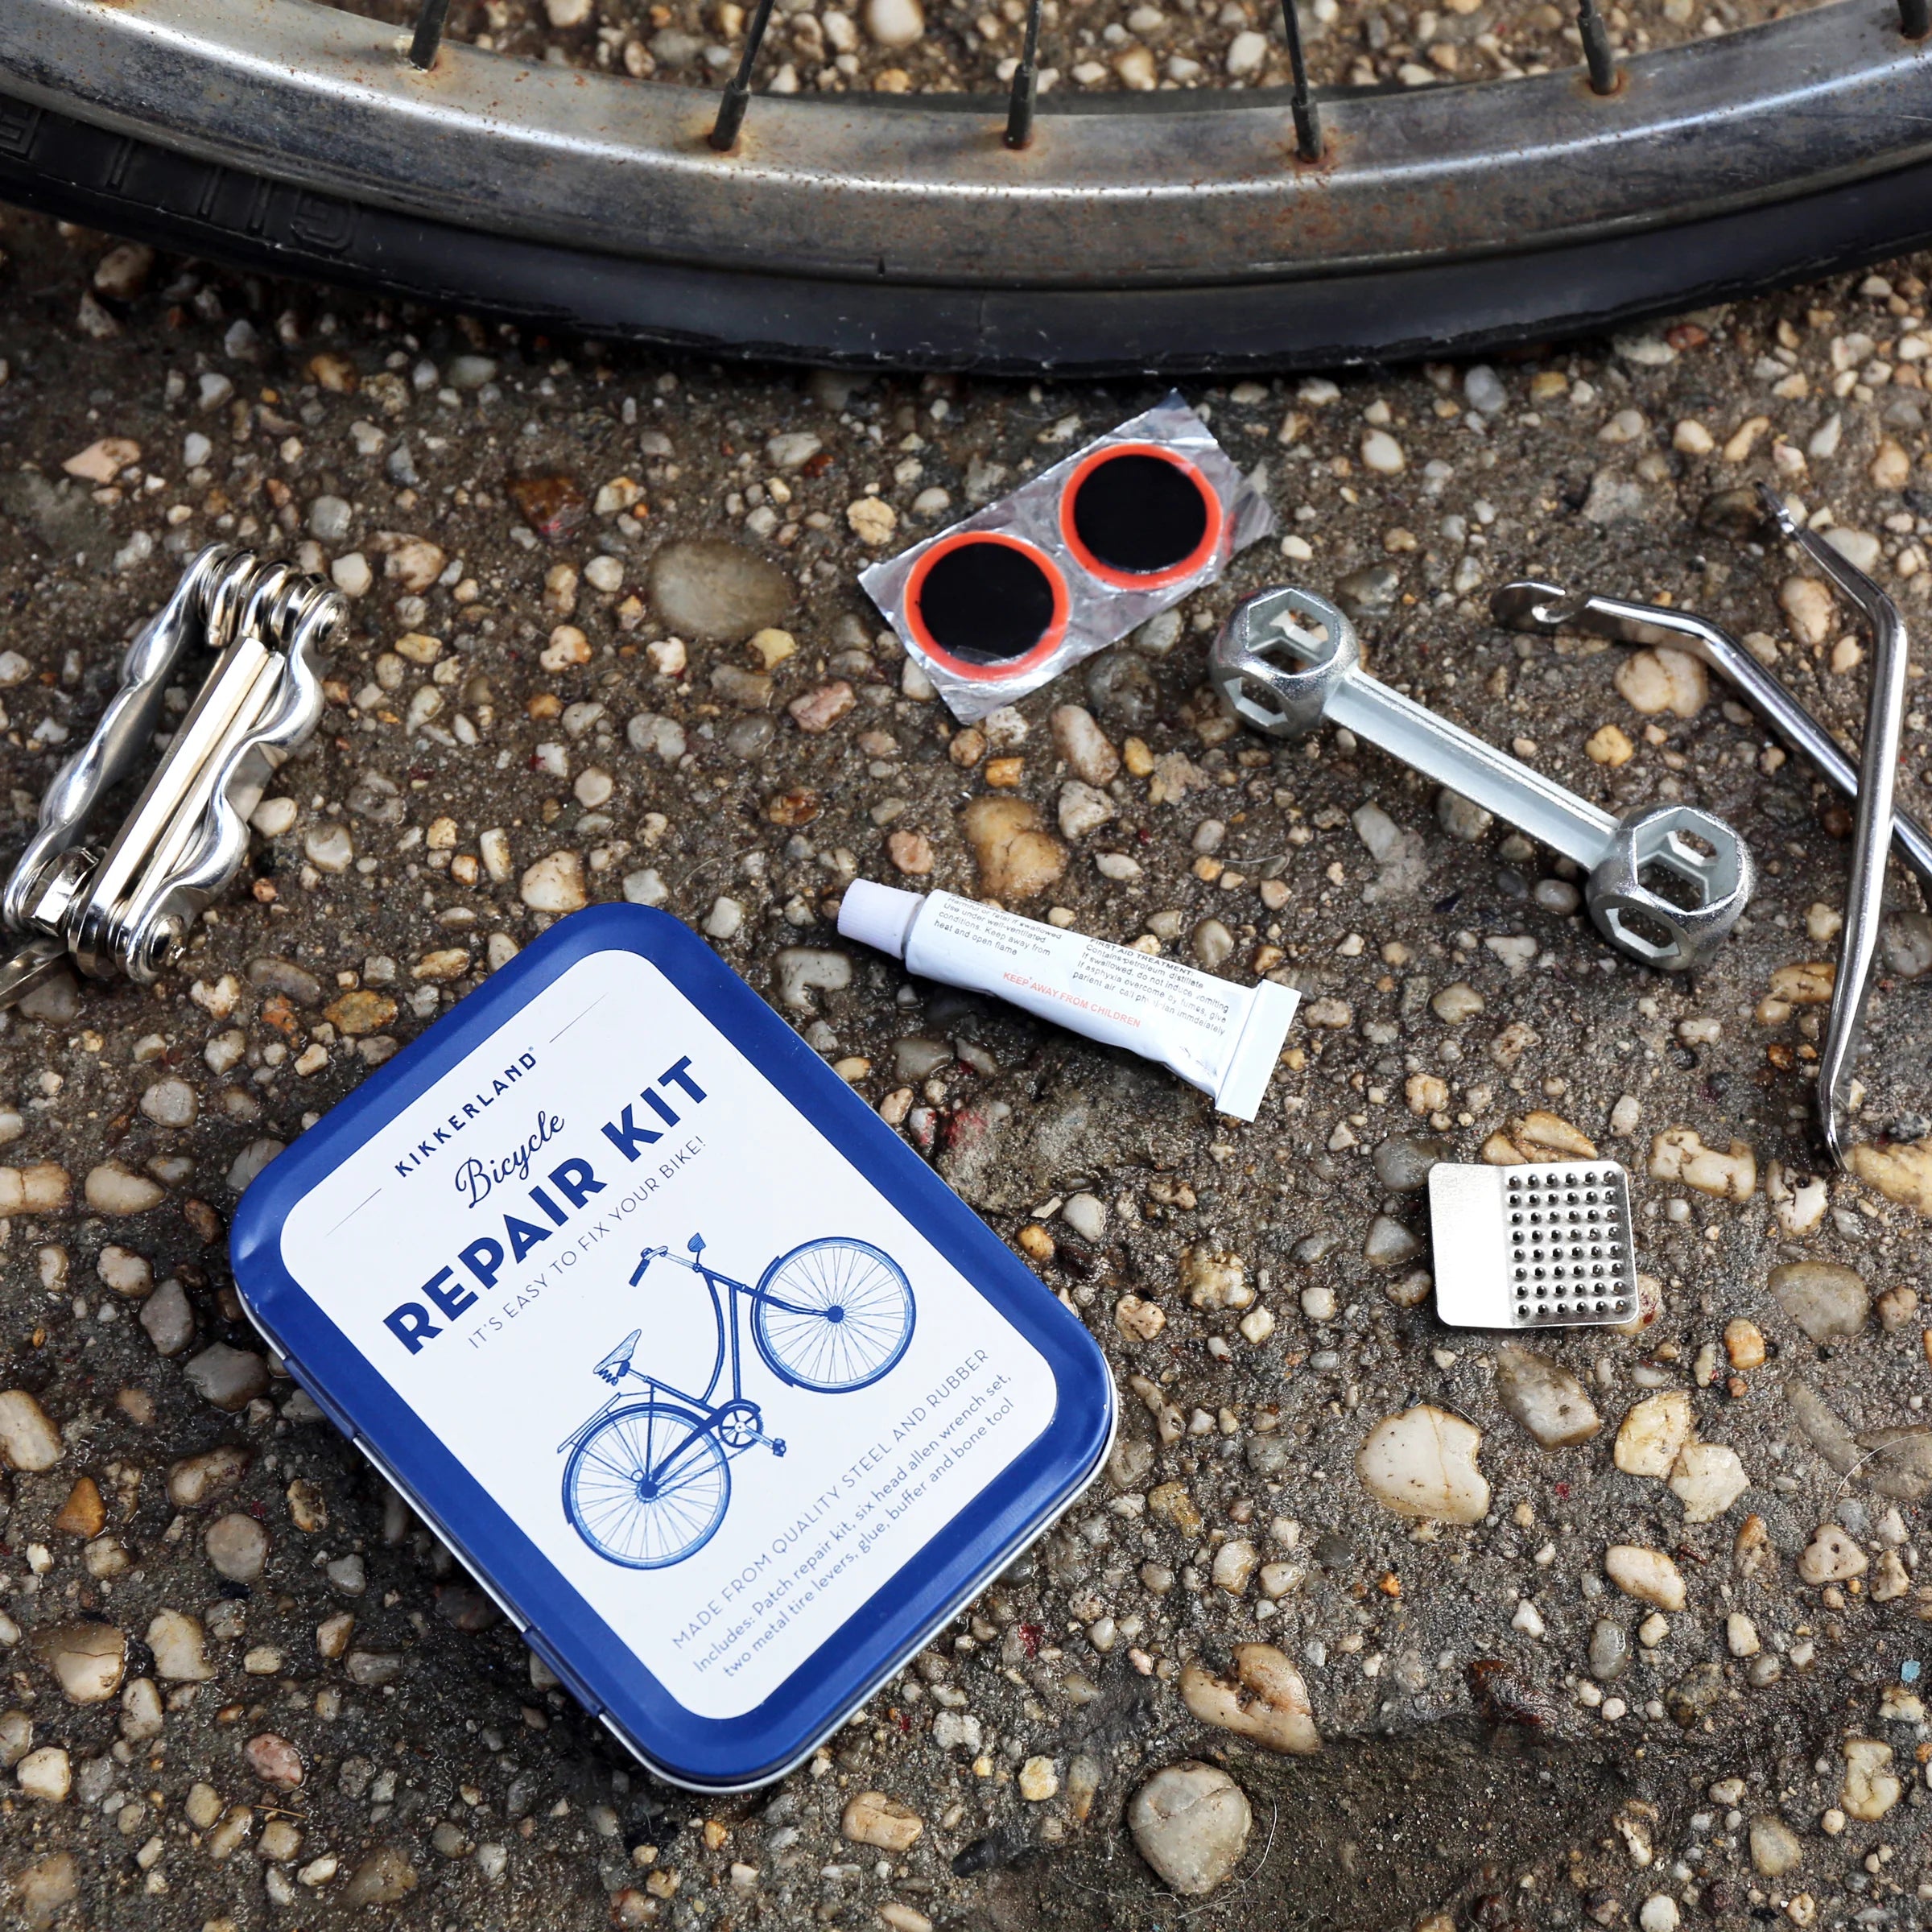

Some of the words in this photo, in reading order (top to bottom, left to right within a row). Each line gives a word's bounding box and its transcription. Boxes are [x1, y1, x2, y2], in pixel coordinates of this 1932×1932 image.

[933, 919, 953, 932] heat
[953, 927, 972, 939] and
[972, 934, 993, 947] open
[994, 941, 1018, 956] flame
[943, 902, 960, 913] Use
[961, 910, 986, 923] under
[987, 919, 1047, 943] well-ventilated
[947, 897, 980, 912] Harmful
[991, 911, 1011, 922] fatal
[1018, 922, 1063, 940] swallowed
[984, 927, 1006, 941] Keep
[1007, 936, 1030, 950] away
[1031, 943, 1051, 956] from
[1084, 943, 1122, 962] Contains
[1122, 957, 1166, 976] petroleum
[1168, 972, 1204, 989] distillate
[1089, 936, 1117, 952] FIRST
[1117, 948, 1134, 957] AID
[1002, 972, 1030, 986] KEEP
[1030, 983, 1059, 997] AWAY
[1059, 993, 1088, 1009] FROM
[1089, 1003, 1141, 1028] CHILDREN
[1084, 965, 1123, 984] asphyxia
[1124, 979, 1166, 998] overcome
[1208, 1012, 1227, 1024] give
[1104, 983, 1117, 992] air
[1136, 972, 1148, 980] do
[1149, 976, 1164, 987] not
[1164, 980, 1193, 997] induce
[456, 1111, 564, 1208] Bicycle
[382, 1158, 608, 1355] REPAIR
[601, 1055, 708, 1162] KIT
[469, 1317, 502, 1348] IT'S
[503, 1274, 547, 1318] EASY
[549, 1251, 576, 1274] TO
[578, 1222, 610, 1251] FIX
[608, 1178, 660, 1220] YOUR
[659, 1136, 705, 1179] BIKE!
[672, 1600, 722, 1649] MADE
[721, 1553, 771, 1602] FROM
[772, 1485, 840, 1554] QUALITY
[842, 1443, 892, 1488] STEEL
[893, 1407, 926, 1442] AND
[926, 1350, 989, 1407] RUBBER
[693, 1617, 755, 1672] Includes:
[752, 1579, 794, 1616] Patch
[794, 1541, 831, 1579] repair
[829, 1521, 856, 1542] kit,
[856, 1501, 875, 1521] six
[871, 1466, 907, 1502] head
[909, 1441, 939, 1470] allen
[939, 1396, 985, 1439] wrench
[986, 1374, 1011, 1396] set,
[723, 1652, 751, 1677] two
[752, 1610, 790, 1651] metal
[788, 1591, 815, 1615] tire
[811, 1554, 858, 1591] levers,
[858, 1523, 890, 1554] glue,
[885, 1481, 927, 1520] buffer
[929, 1454, 954, 1482] and
[950, 1427, 987, 1458] bone
[985, 1397, 1013, 1426] tool
